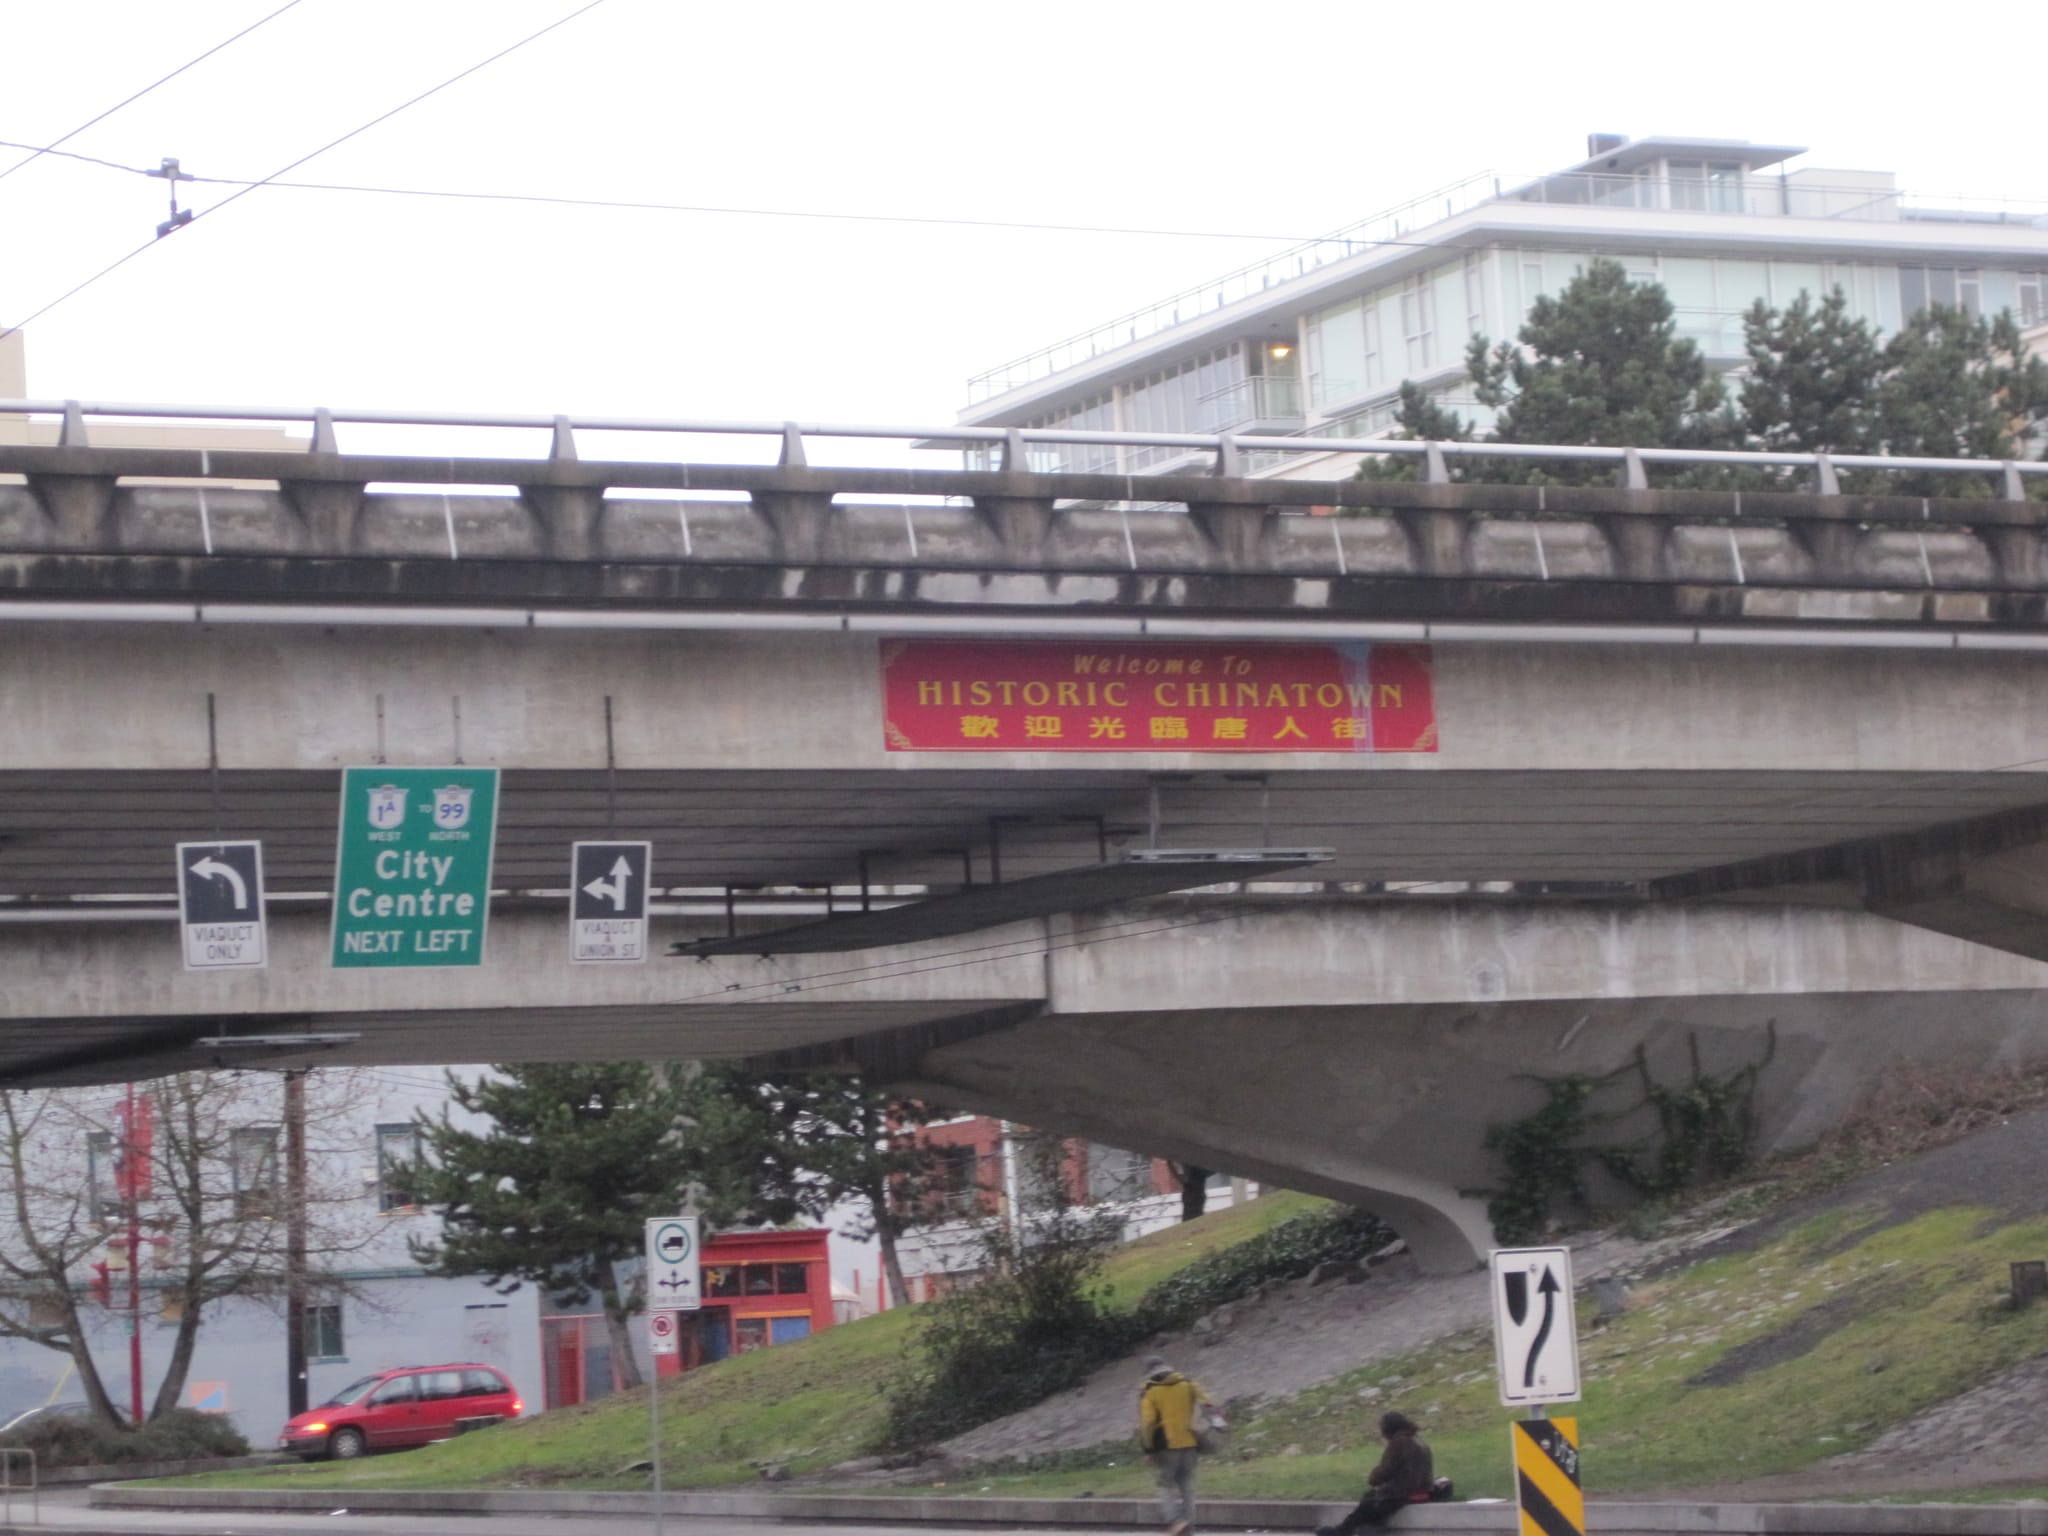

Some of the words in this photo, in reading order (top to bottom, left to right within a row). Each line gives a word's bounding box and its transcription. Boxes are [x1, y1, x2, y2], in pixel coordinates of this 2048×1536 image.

[1073, 654, 1203, 675] Welcome
[1222, 655, 1251, 675] To
[917, 679, 1129, 707] HISTORIC
[1153, 681, 1404, 708] CHINATOWN
[960, 714, 1367, 740] 歡迎光臨唐人街
[440, 803, 465, 820] 99
[367, 831, 402, 842] WEST
[375, 849, 454, 887] City
[348, 887, 475, 918] Centre
[206, 943, 242, 960] ONLY
[343, 929, 404, 953] NEXT
[414, 928, 473, 952] LEFT
